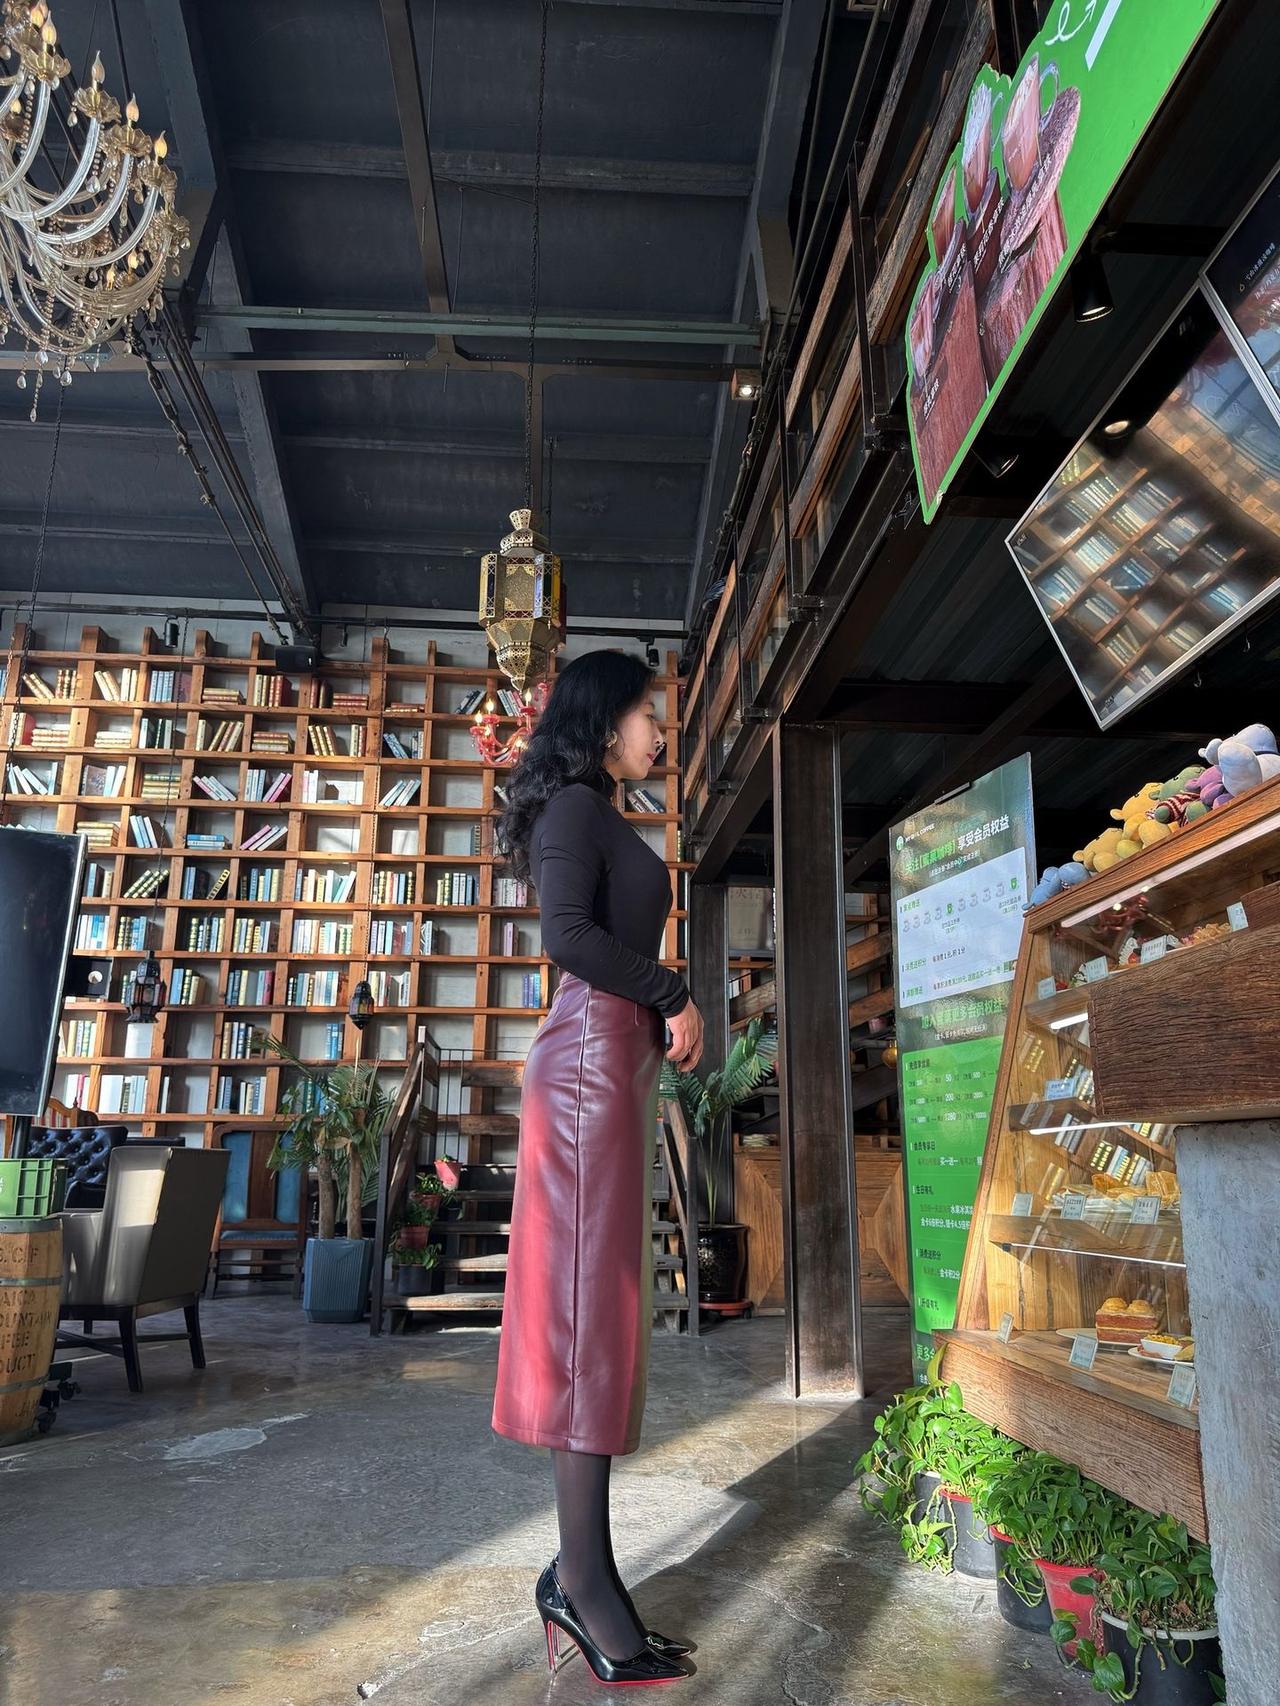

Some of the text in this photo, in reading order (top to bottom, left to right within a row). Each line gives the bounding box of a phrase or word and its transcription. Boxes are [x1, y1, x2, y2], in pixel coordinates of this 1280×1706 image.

[957, 814, 1010, 851] 享受会员权益
